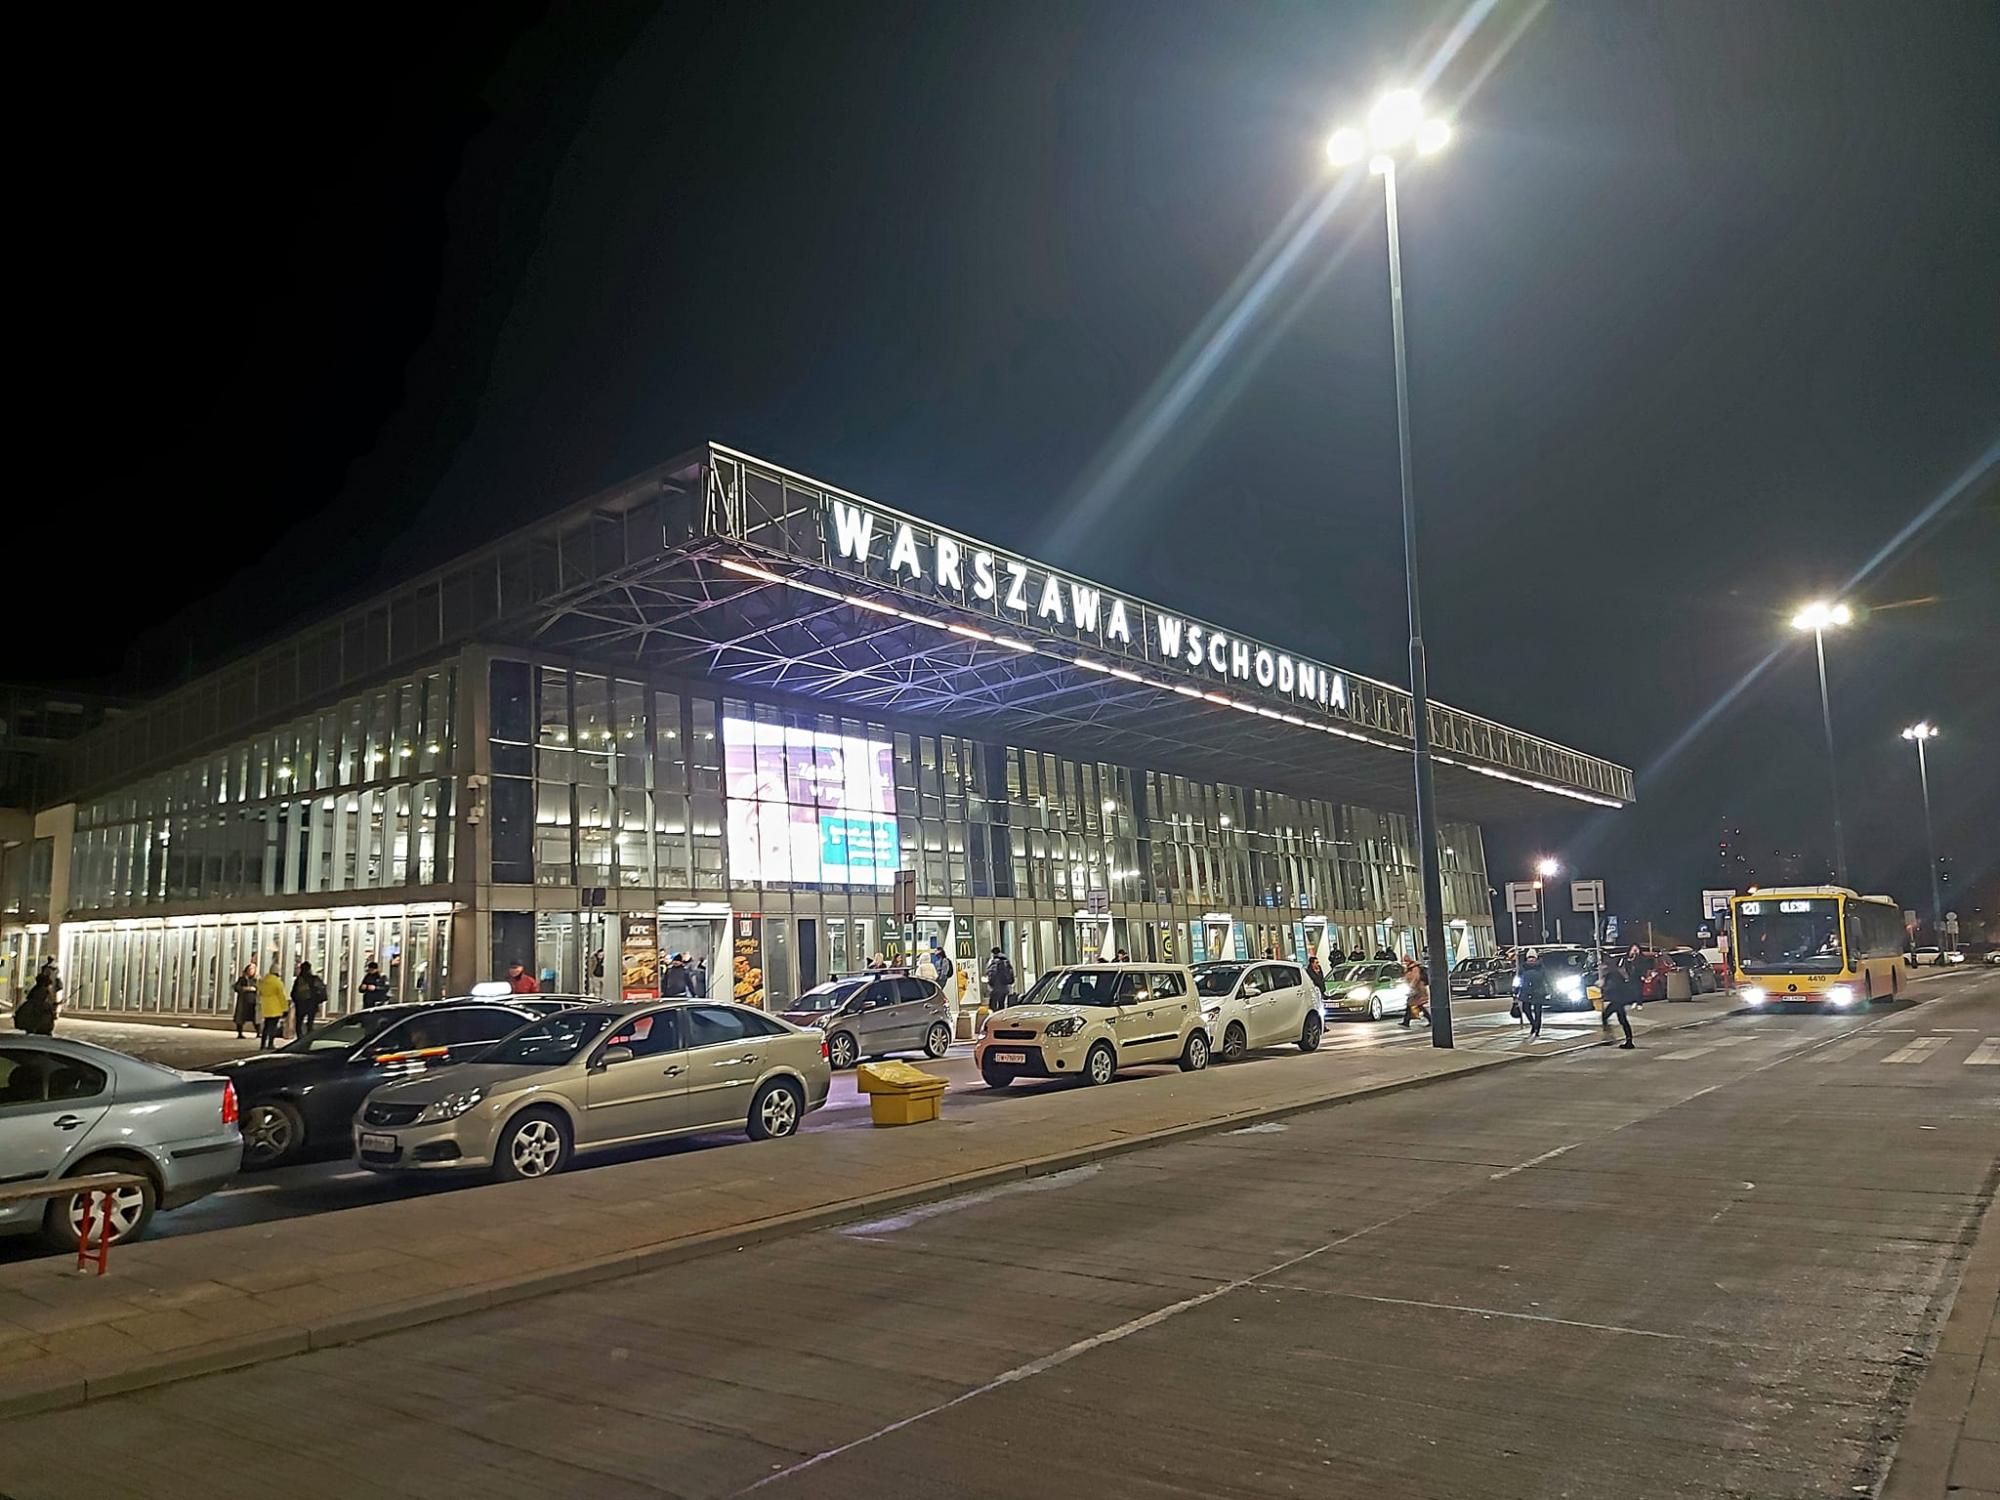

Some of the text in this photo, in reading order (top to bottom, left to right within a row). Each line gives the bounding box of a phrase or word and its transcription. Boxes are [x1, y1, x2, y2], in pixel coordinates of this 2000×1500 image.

[834, 500, 1346, 710] WARSZAWA WSCHODNIA
[1740, 902, 1760, 915] 120
[629, 925, 649, 935] KFC
